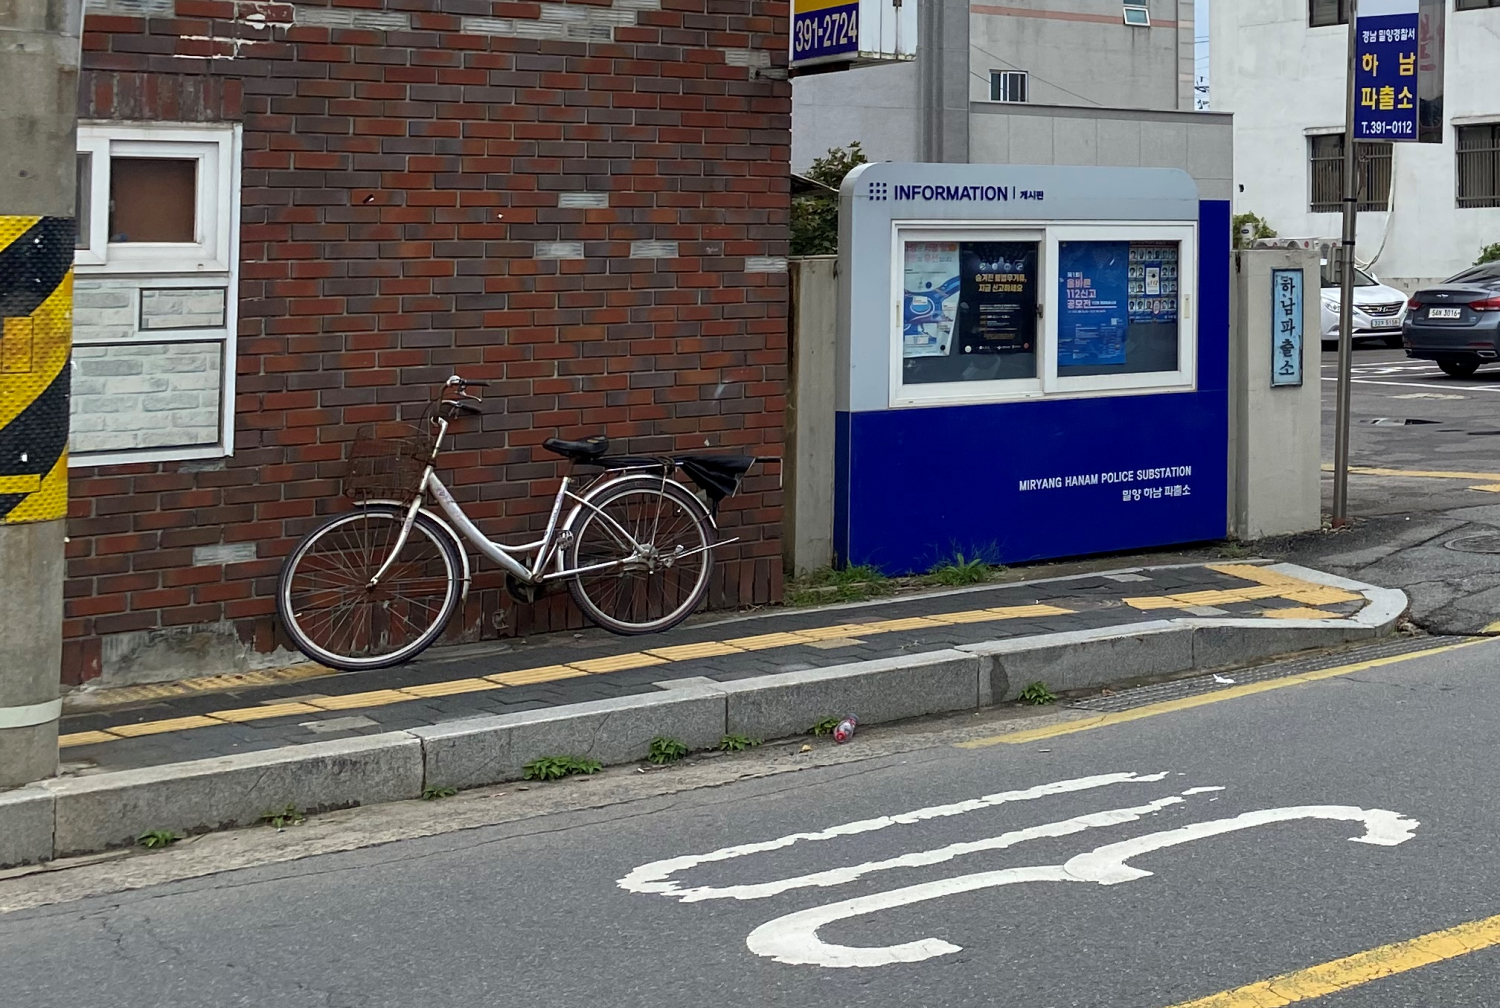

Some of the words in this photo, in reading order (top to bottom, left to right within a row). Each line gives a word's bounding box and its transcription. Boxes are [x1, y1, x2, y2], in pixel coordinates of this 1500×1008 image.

[795, 9, 858, 52] 391-2724
[1362, 30, 1377, 43] 경남
[1378, 28, 1416, 43] 밀양경찰서
[1361, 85, 1414, 111] 파출소
[894, 185, 1008, 201] INFORMATION
[1019, 190, 1044, 201] 게시판
[1067, 289, 1096, 299] 112신고
[1067, 299, 1091, 309] 공모전
[1278, 275, 1296, 376] 하남파출소
[1019, 477, 1062, 491] MIRYANG
[1065, 474, 1099, 487] HANAM
[1101, 470, 1134, 483] POLICE
[1136, 465, 1192, 481] SUBSTATION
[1122, 489, 1142, 502] 밀양
[1143, 487, 1162, 499] 하남
[1164, 484, 1191, 497] 파출소
